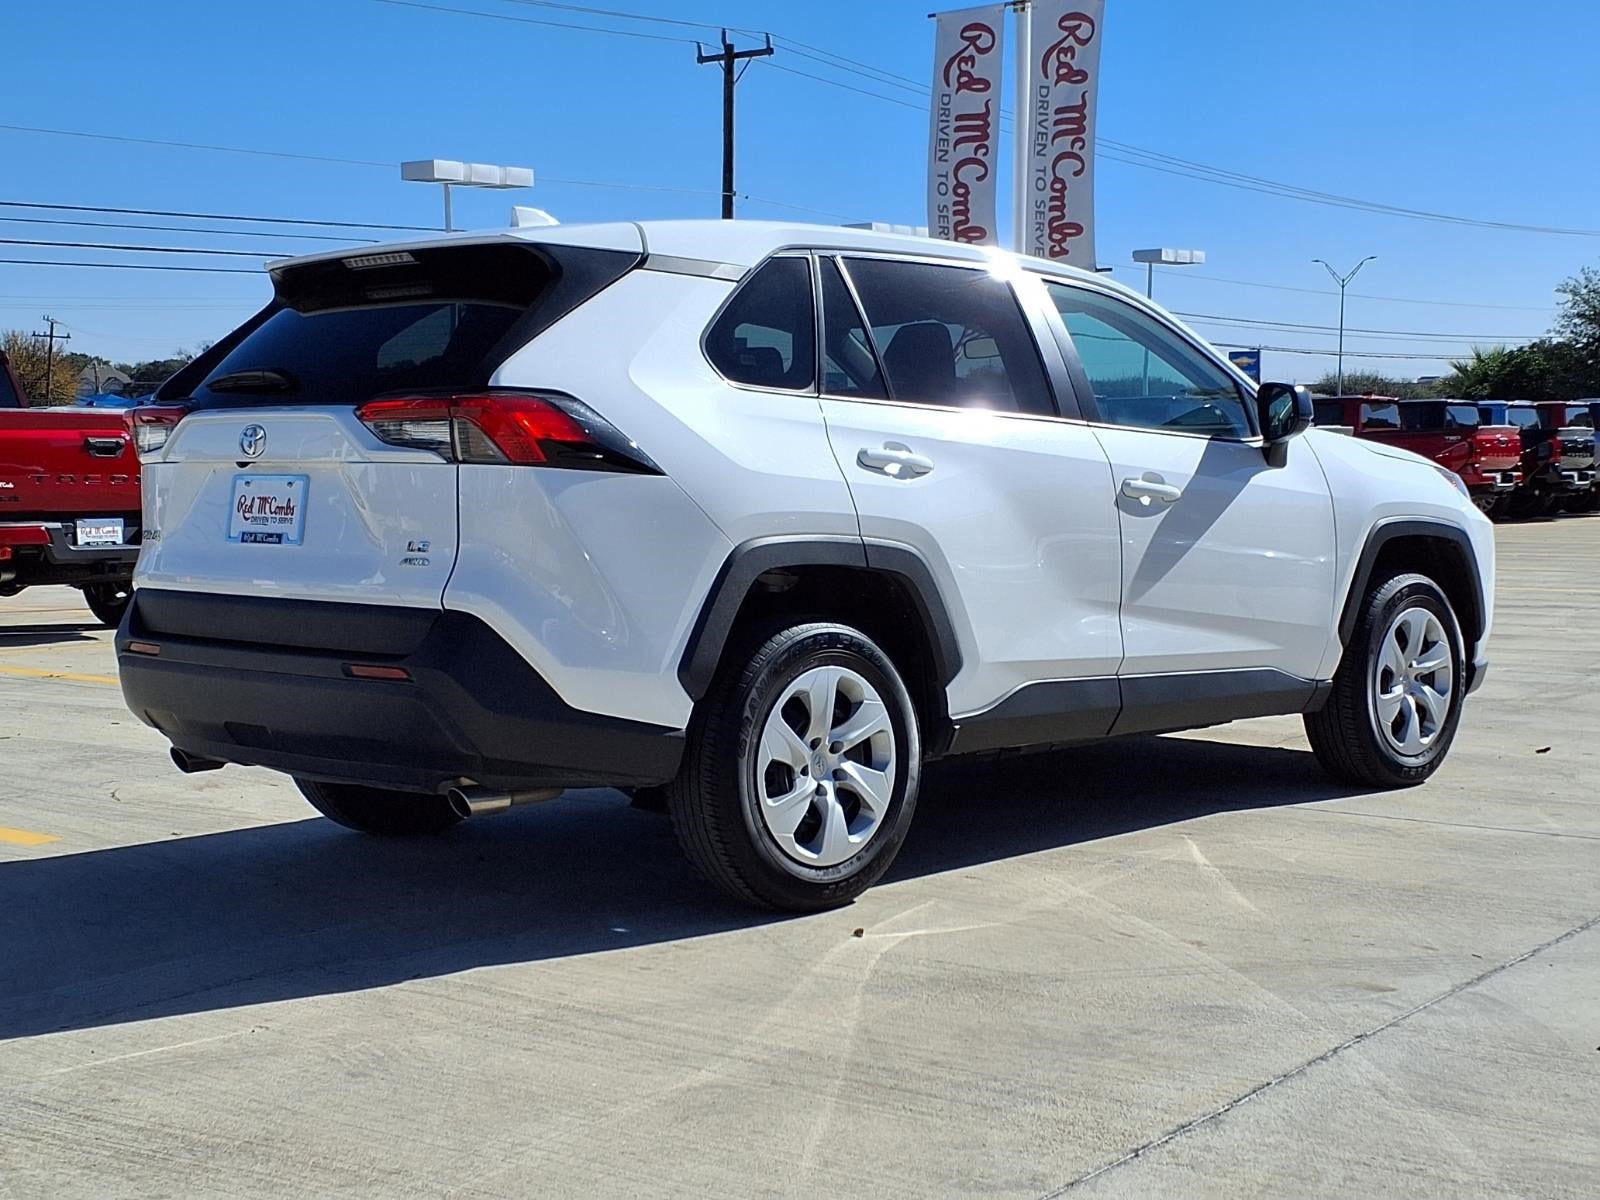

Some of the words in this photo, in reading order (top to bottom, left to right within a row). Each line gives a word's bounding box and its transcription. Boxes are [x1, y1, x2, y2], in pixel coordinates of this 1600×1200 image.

[943, 22, 996, 95] Red
[1041, 12, 1095, 87] Red
[937, 93, 951, 163] DRIVEN
[1036, 85, 1050, 158] DRIVEN
[936, 171, 949, 197] TO
[952, 98, 992, 244] McComb
[1035, 165, 1047, 192] TO
[1048, 90, 1089, 258] McCombs
[937, 204, 950, 241] SER
[1034, 199, 1047, 257] SERVE
[237, 494, 255, 521] Red
[257, 496, 295, 516] McCombs
[270, 516, 277, 524] TO
[278, 517, 293, 525] SERVE
